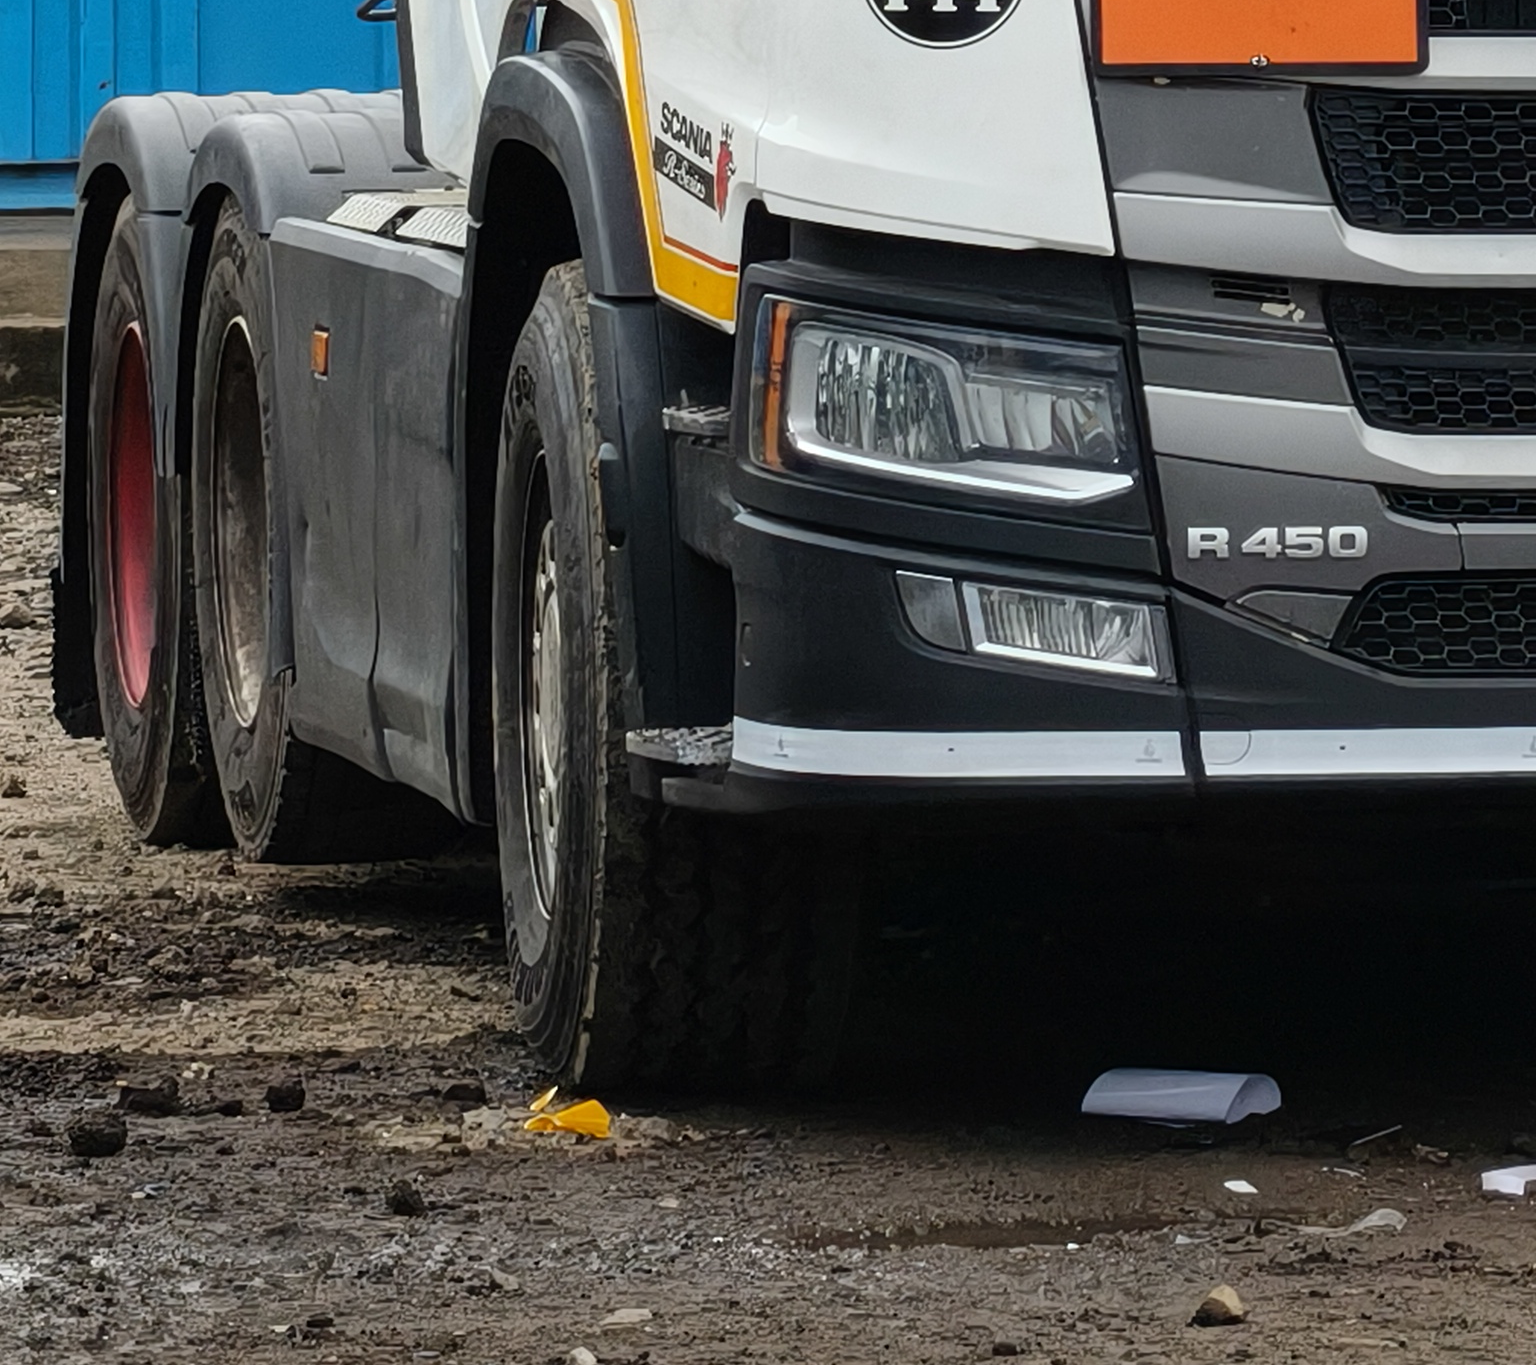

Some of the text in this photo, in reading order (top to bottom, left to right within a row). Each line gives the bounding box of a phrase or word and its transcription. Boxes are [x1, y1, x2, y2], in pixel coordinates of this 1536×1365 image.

[660, 101, 714, 165] SCANIA
[1187, 525, 1368, 559] R 450
